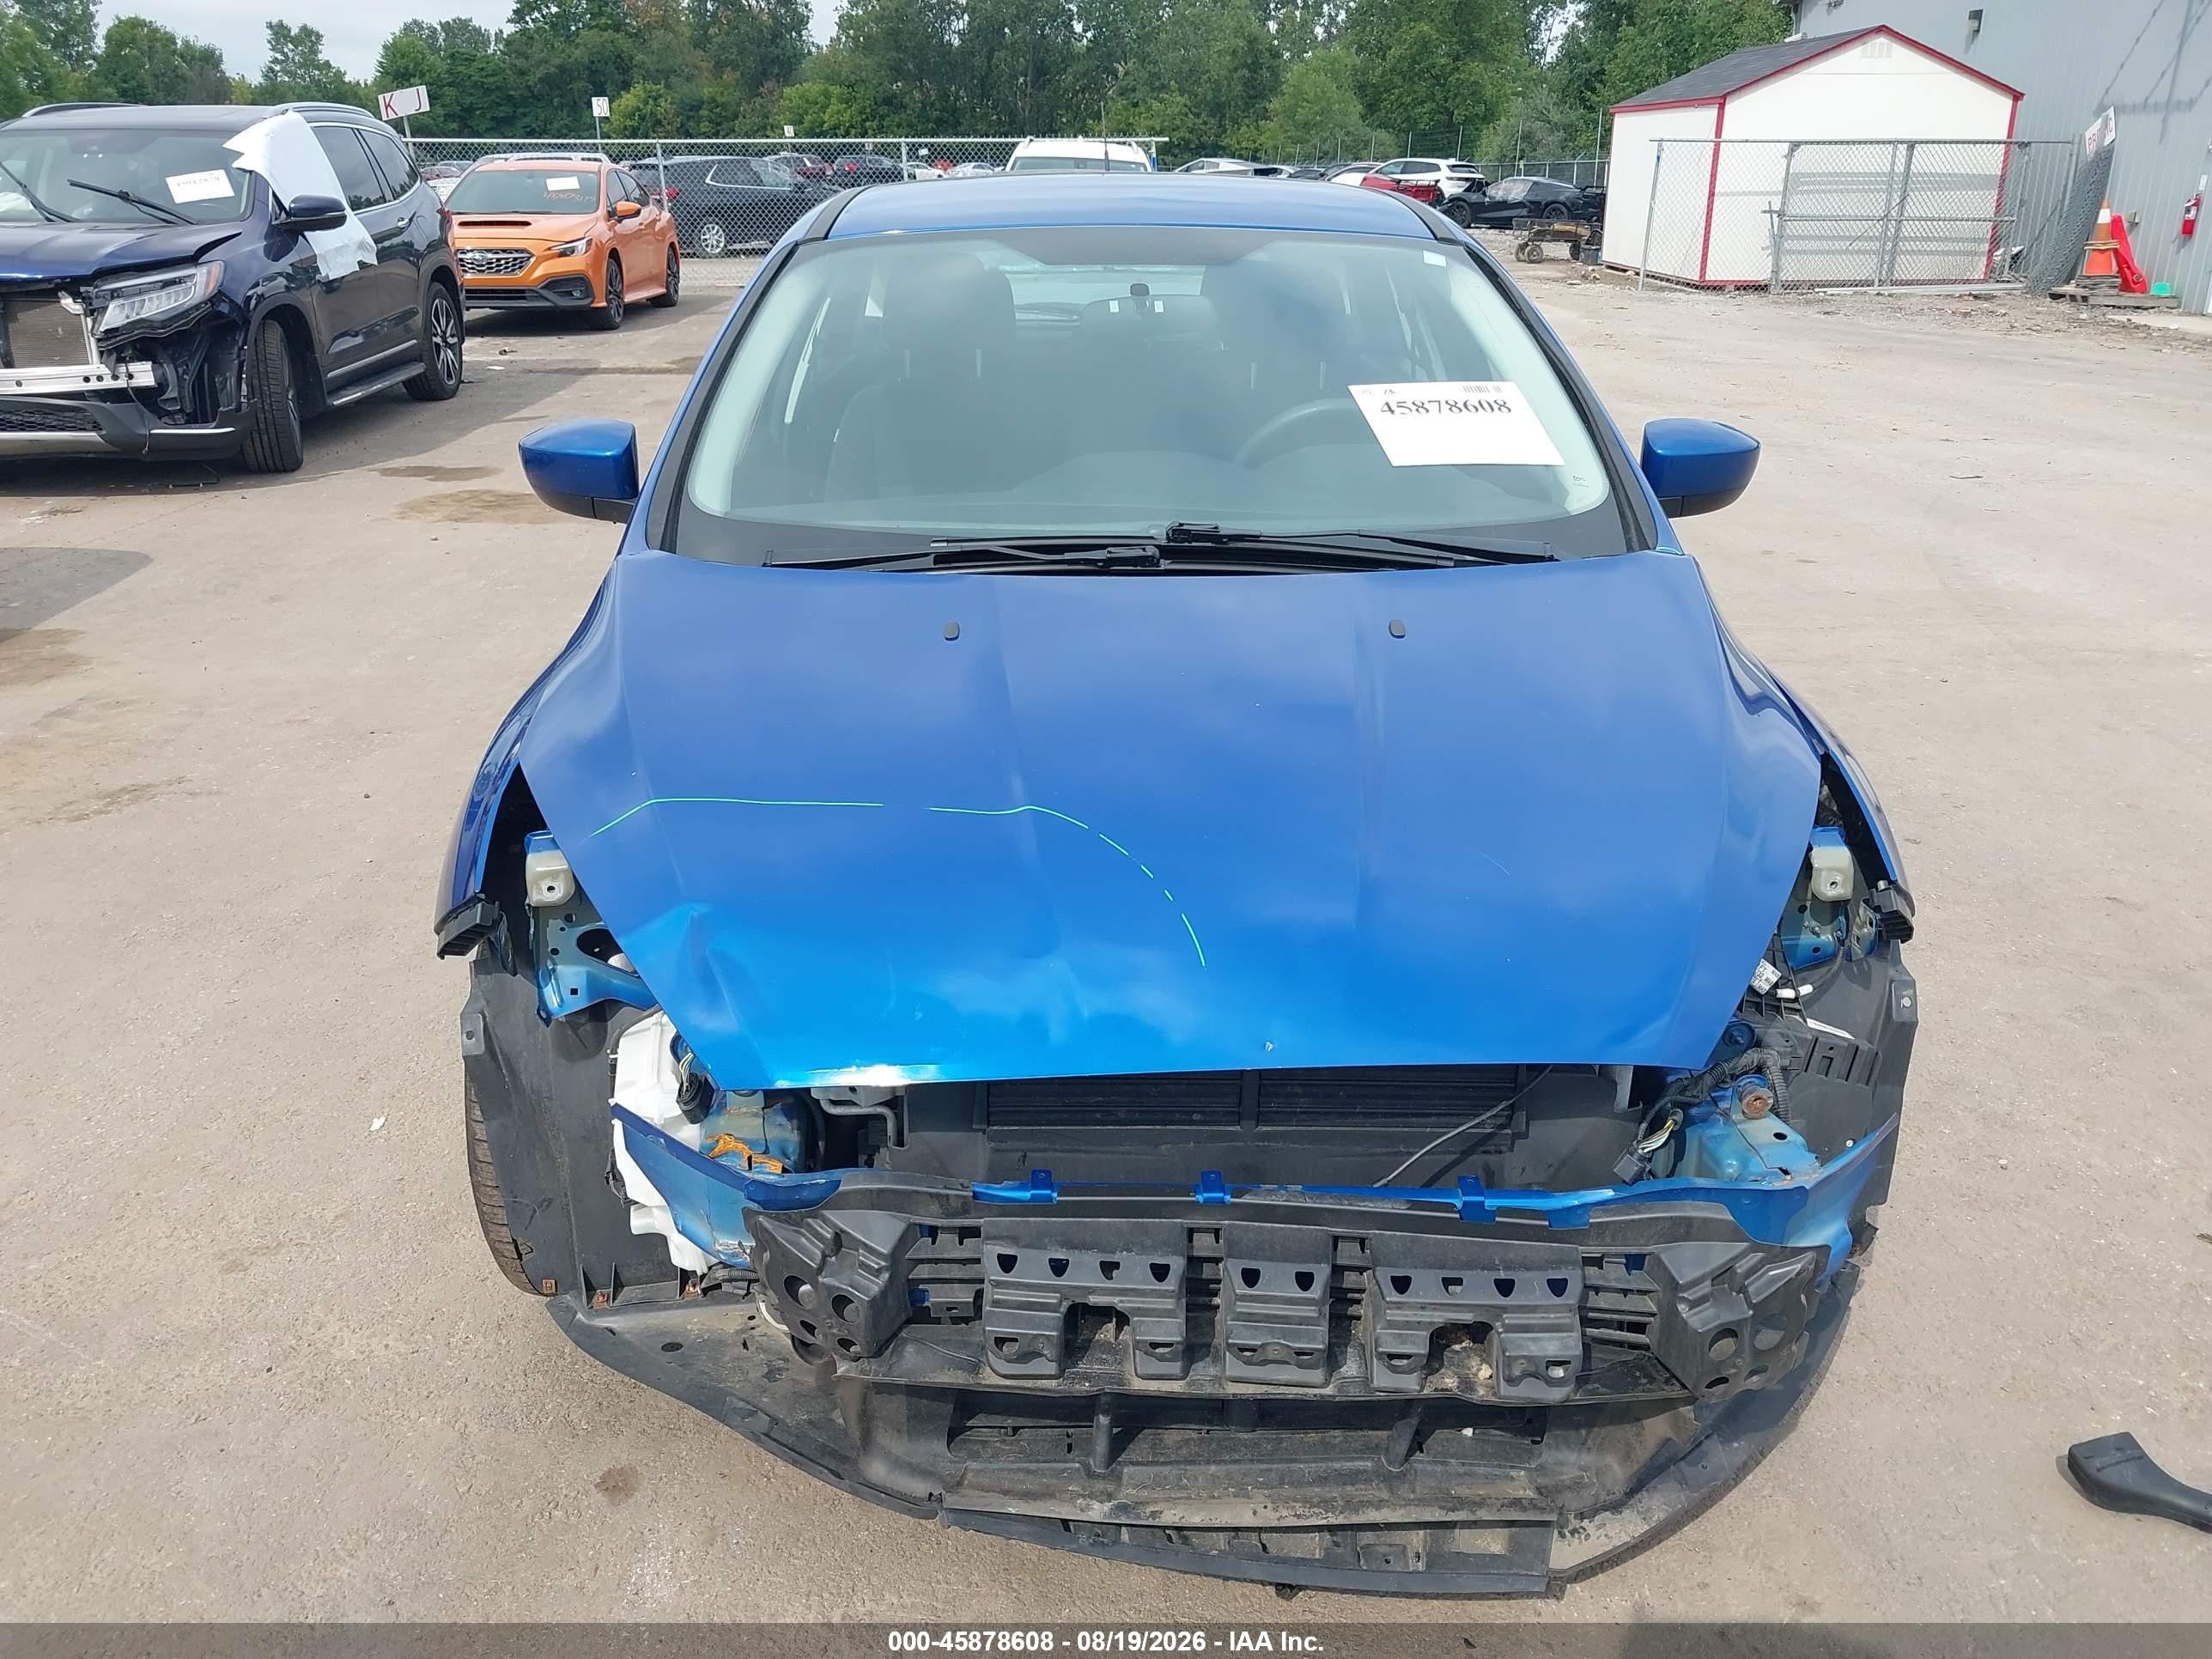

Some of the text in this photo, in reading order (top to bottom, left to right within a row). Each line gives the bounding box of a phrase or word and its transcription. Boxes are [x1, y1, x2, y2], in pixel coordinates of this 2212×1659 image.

[382, 88, 422, 118] K J
[596, 98, 609, 116] 50
[1380, 398, 1512, 416] 45878608
